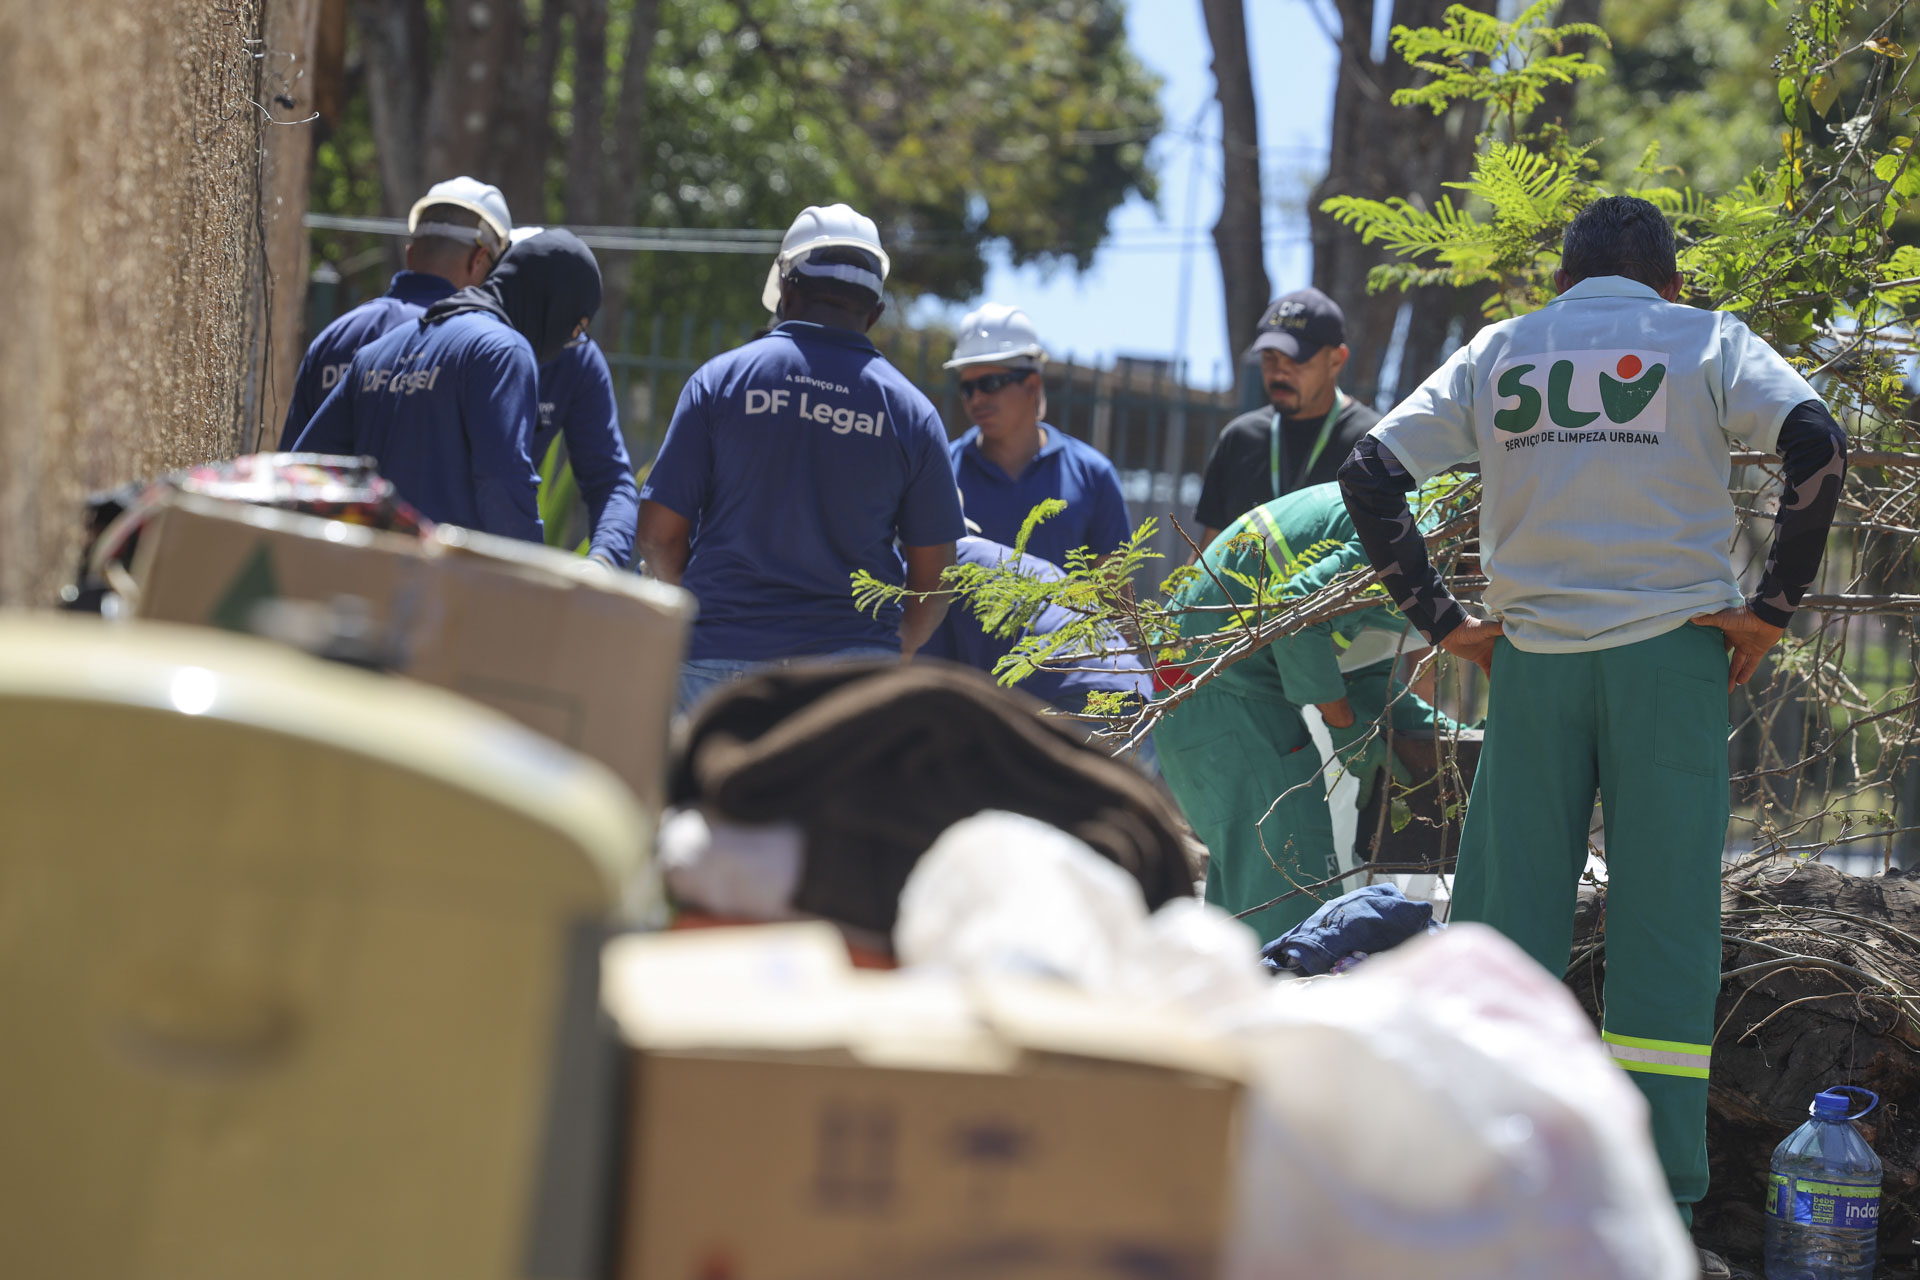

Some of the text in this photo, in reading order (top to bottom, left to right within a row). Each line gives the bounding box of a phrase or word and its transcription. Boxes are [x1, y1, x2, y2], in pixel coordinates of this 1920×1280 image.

[362, 369, 391, 393] DF
[785, 374, 850, 394] A SERVIÇO DA
[745, 389, 885, 437] DF Legal
[1505, 431, 1659, 452] SERVIÇO DE LIMPEZA URBANA
[1813, 1195, 1835, 1205] beba
